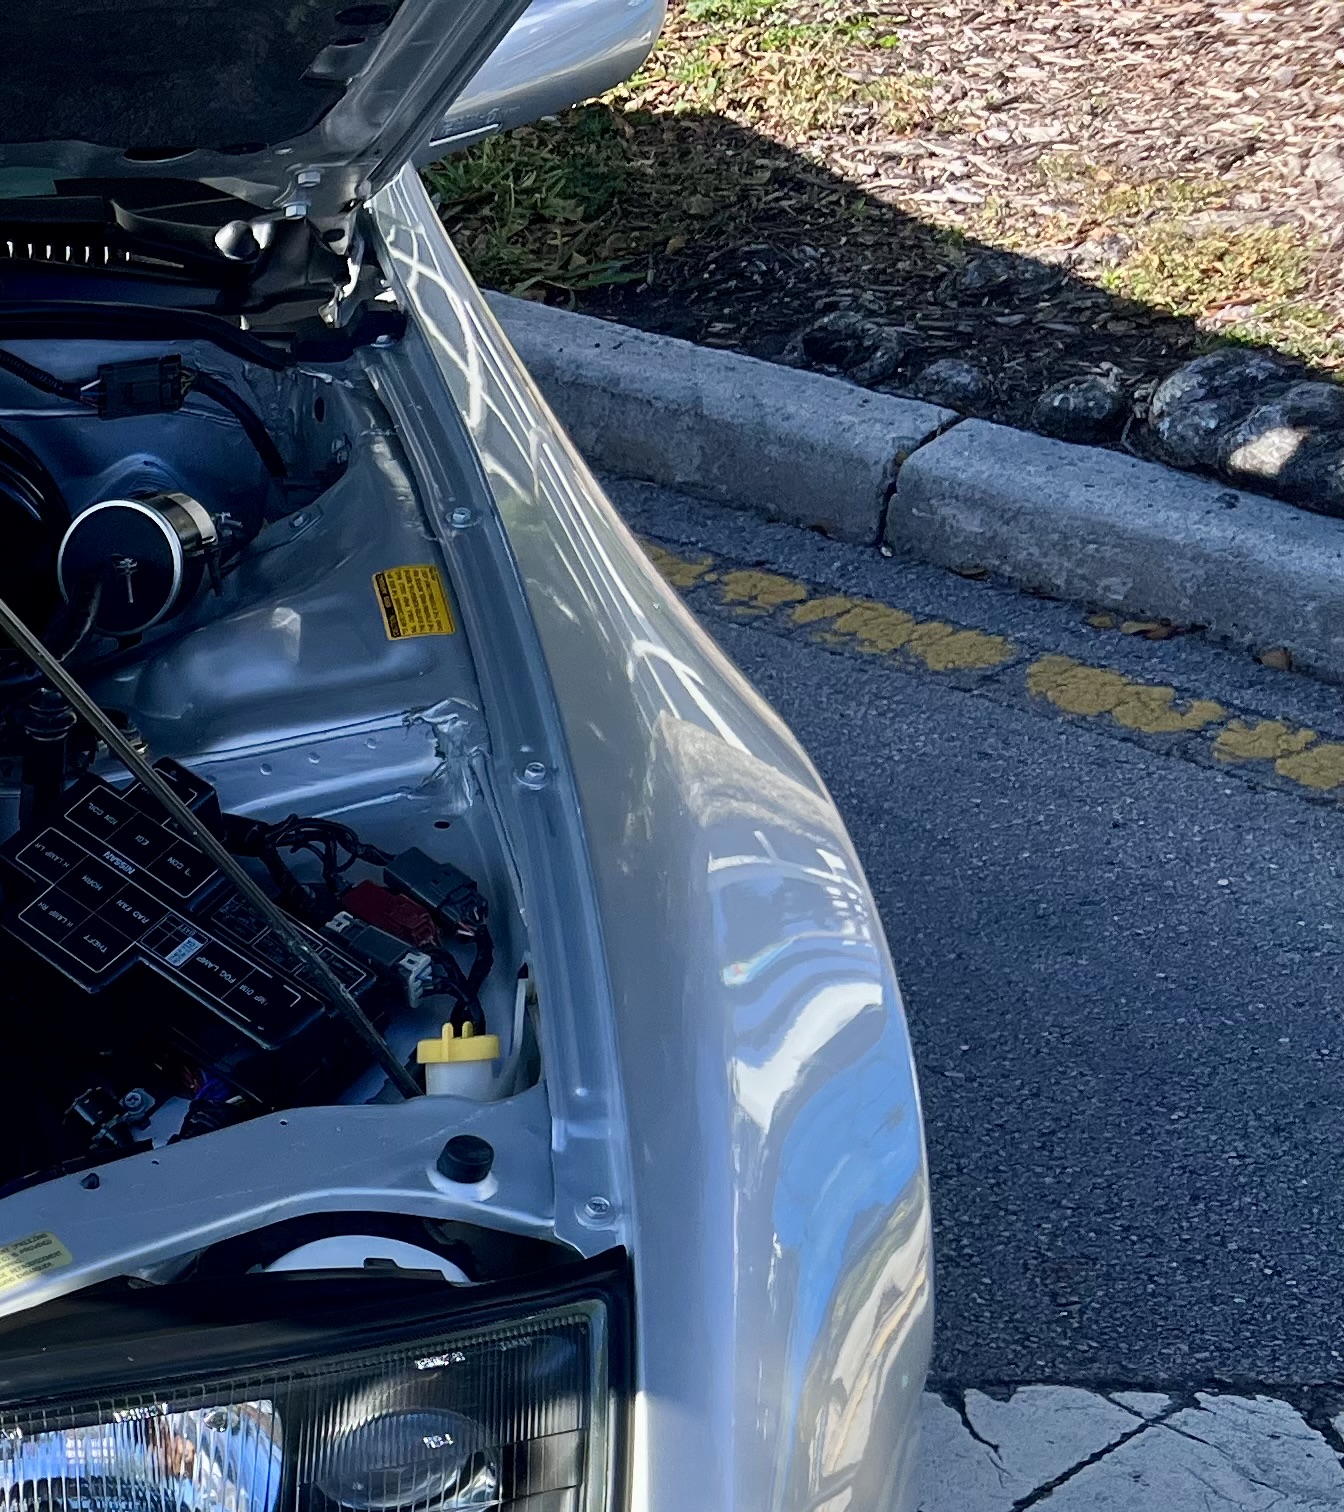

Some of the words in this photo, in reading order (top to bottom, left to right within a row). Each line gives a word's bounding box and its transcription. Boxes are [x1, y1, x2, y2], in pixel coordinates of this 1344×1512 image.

[102, 850, 136, 875] NISSAN
[82, 874, 103, 890] HORN
[115, 899, 132, 912] FAN
[132, 909, 150, 924] RAD
[83, 934, 108, 953] THEFT
[196, 956, 220, 972] LAMP
[219, 969, 237, 984] FOG
[19, 1238, 53, 1254] PROVIDED
